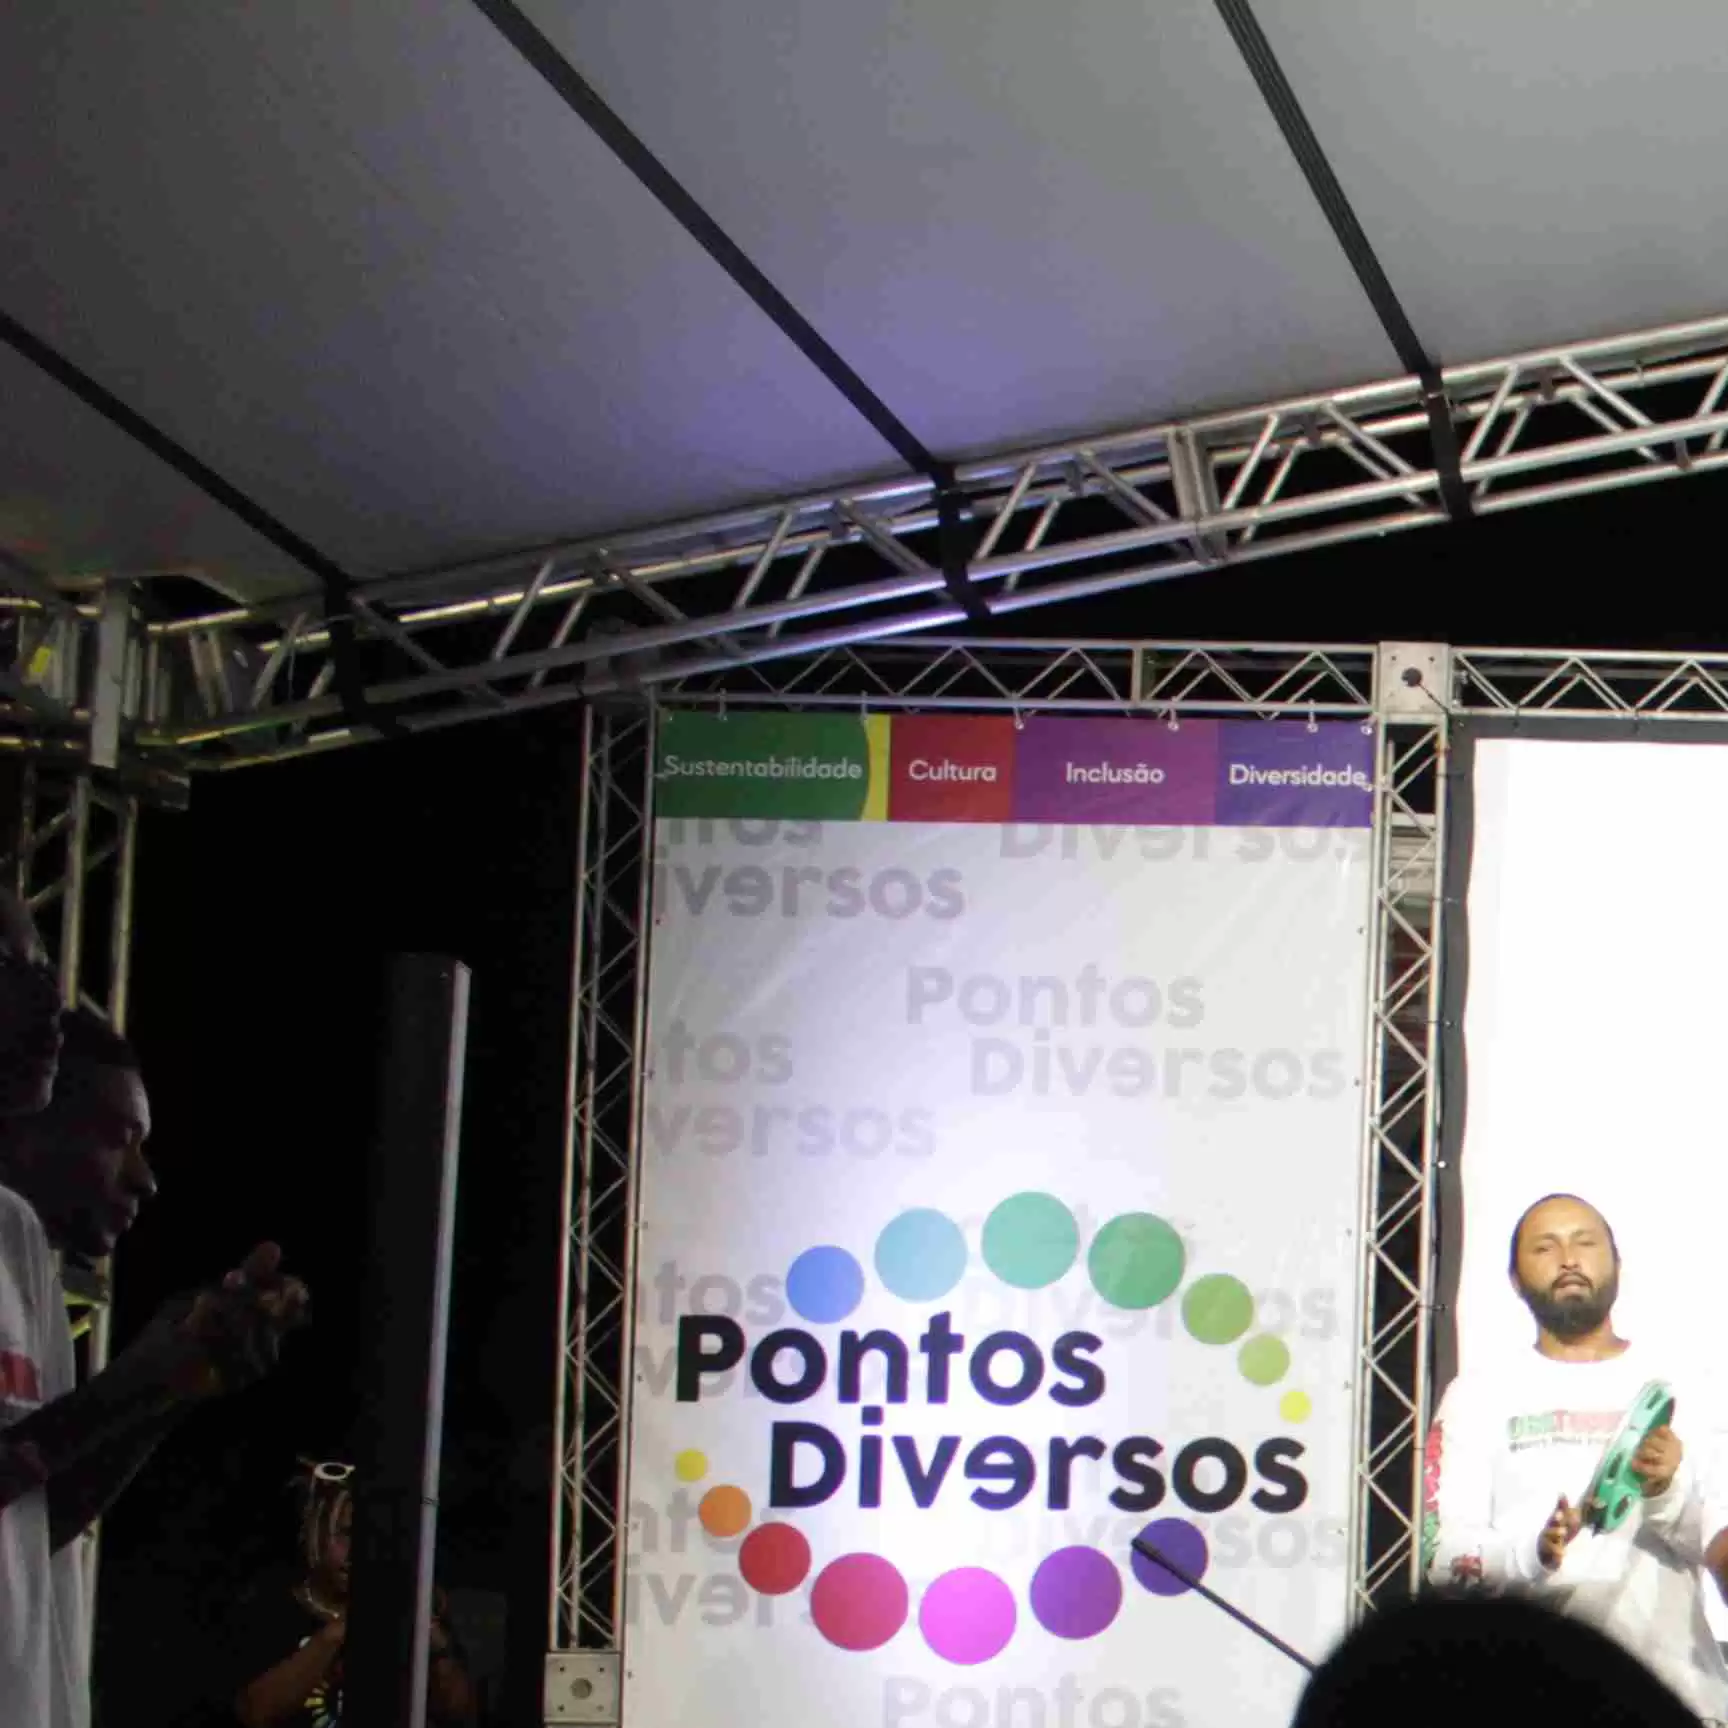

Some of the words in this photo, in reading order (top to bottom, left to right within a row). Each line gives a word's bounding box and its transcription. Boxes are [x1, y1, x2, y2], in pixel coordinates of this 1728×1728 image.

[664, 753, 863, 781] Sustentabilidade
[908, 758, 997, 783] Cultura
[1065, 758, 1165, 786] Inclusão
[1229, 763, 1367, 788] Diversidade
[906, 961, 1204, 1028] Pontos
[647, 1018, 794, 1085] tos
[970, 1028, 1346, 1100] Diversos
[675, 1310, 1107, 1406] Pontos
[769, 1406, 1311, 1513] Diversos
